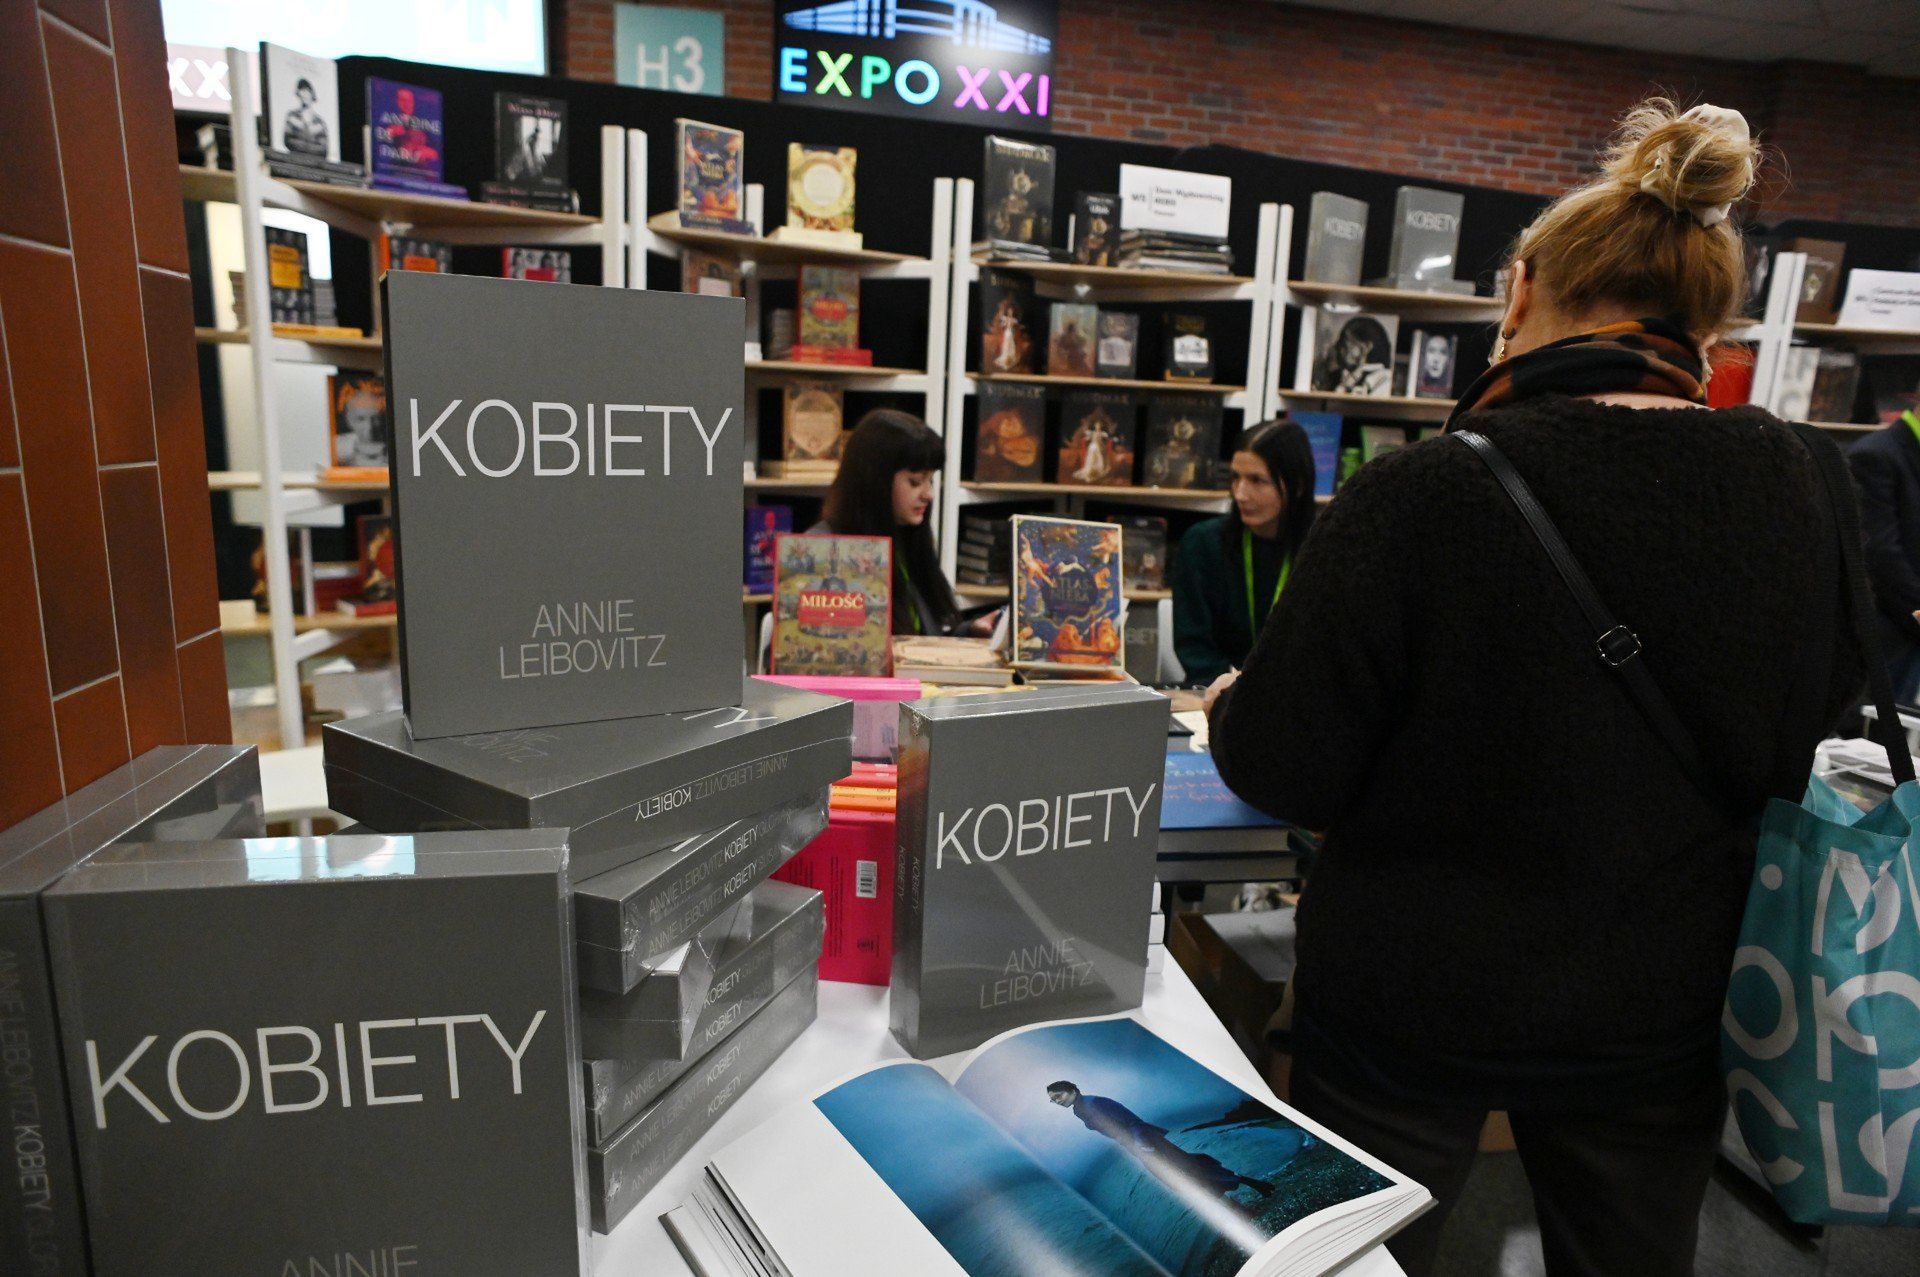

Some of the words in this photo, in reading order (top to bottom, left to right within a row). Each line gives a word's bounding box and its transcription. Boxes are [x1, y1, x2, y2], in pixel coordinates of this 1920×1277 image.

[636, 36, 706, 94] H3
[780, 47, 941, 105] EXPO
[953, 65, 1051, 117] XXI
[1406, 210, 1460, 232] KOBIETY
[410, 398, 733, 477] KOBIETY
[532, 599, 636, 638] ANNIE
[800, 593, 864, 609] MIŁOŚĆ
[499, 634, 668, 680] LEIBOVITZ
[696, 764, 754, 800] LEIBOVITZ
[757, 752, 790, 778] ANNIE
[635, 786, 692, 822] KOBIETY
[936, 783, 1157, 869] KOBIETY
[679, 848, 724, 895] LEIBOVITZ
[724, 825, 759, 863] KOBIETY
[724, 859, 758, 899] KOBIETY
[1004, 937, 1076, 976] ANNIE
[702, 968, 742, 1009] KOBIETY
[979, 960, 1097, 1010] LEIBOVITZ
[705, 999, 744, 1041] KOBIETY
[85, 1010, 547, 1130] KOBIETY
[706, 1041, 742, 1086] KOBIETY
[707, 1073, 743, 1117] KOBIETY
[15, 1124, 52, 1212] KOBIETY
